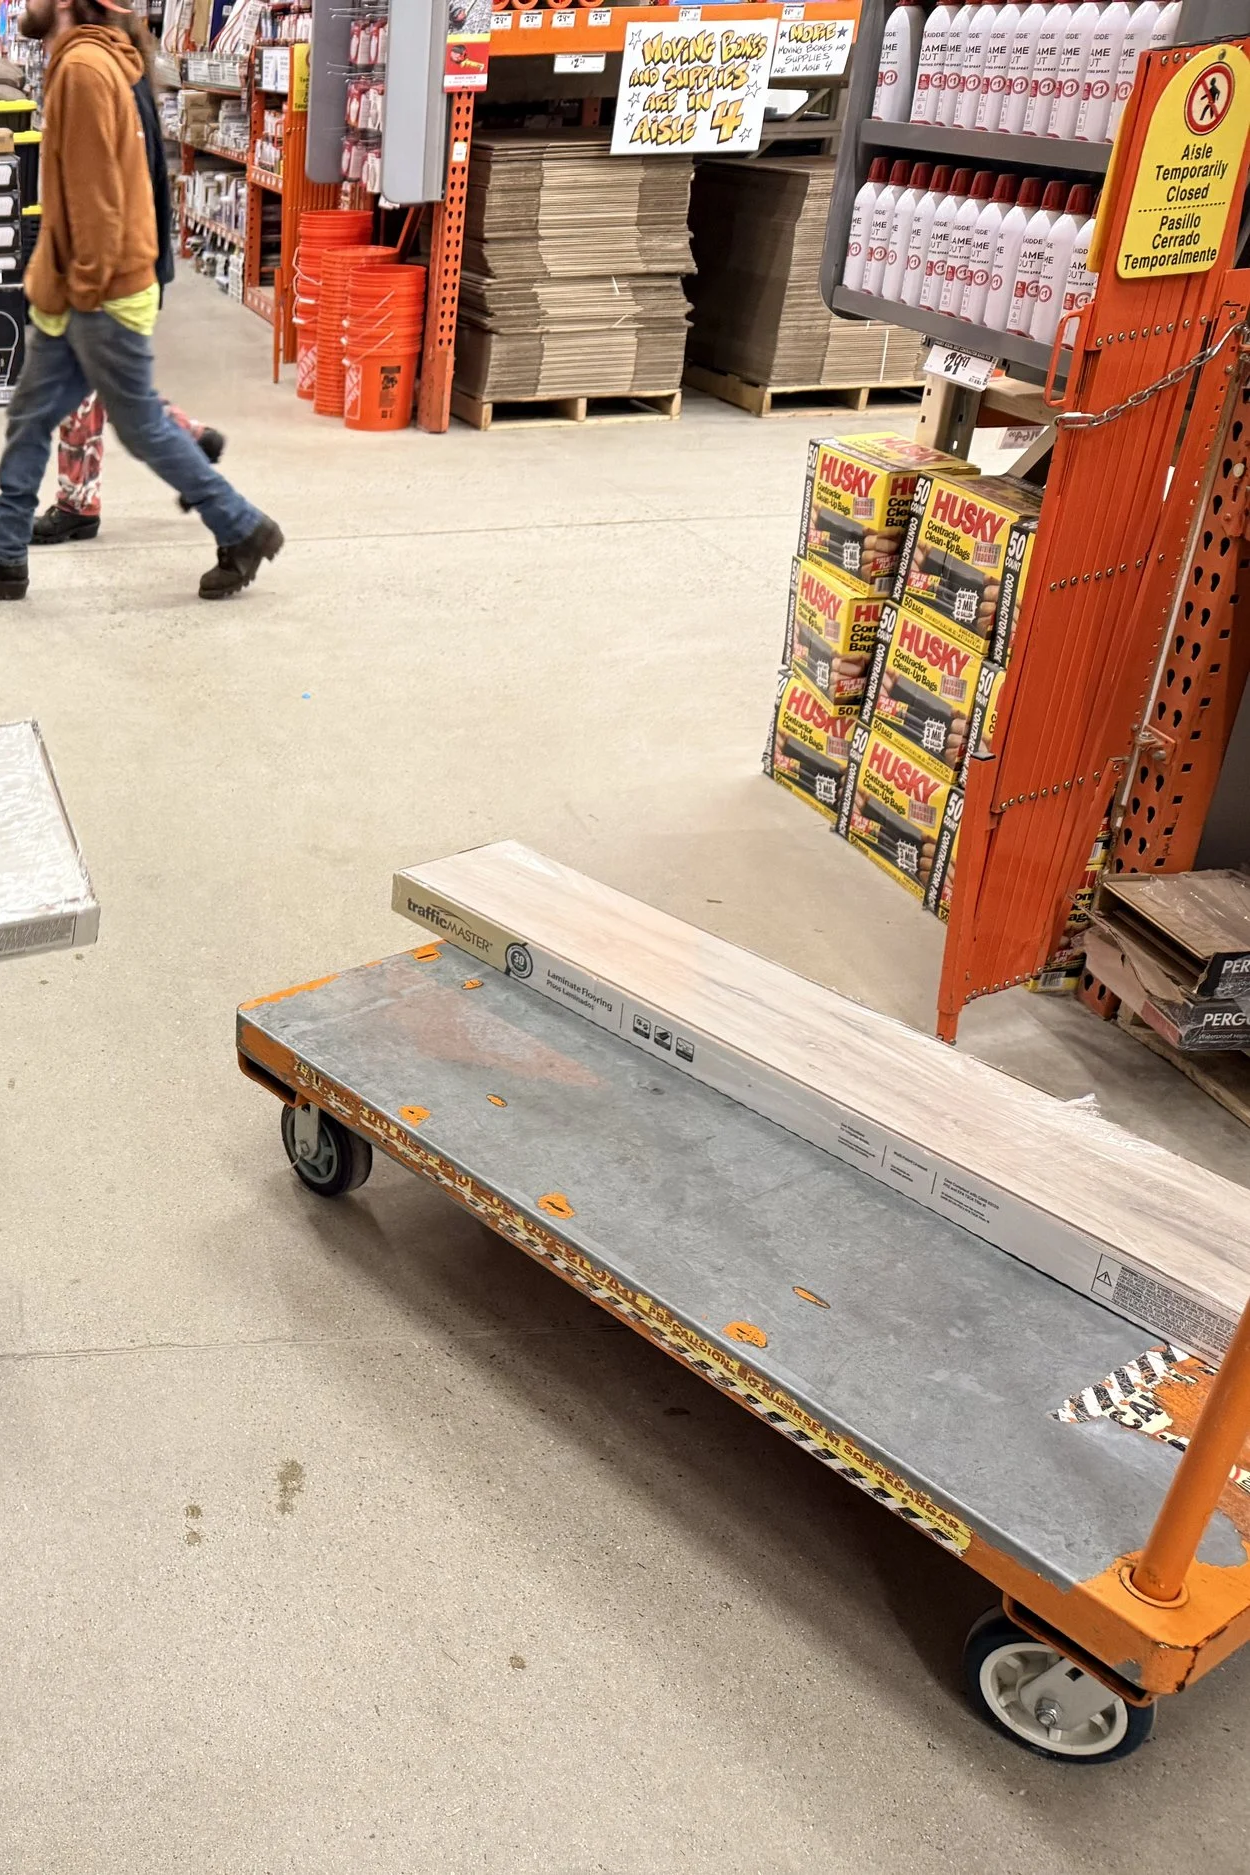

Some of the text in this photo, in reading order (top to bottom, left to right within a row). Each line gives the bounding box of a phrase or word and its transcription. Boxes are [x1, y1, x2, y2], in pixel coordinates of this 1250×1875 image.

[789, 22, 837, 42] MORE
[642, 30, 768, 65] MOVING BOXES
[778, 45, 803, 54] MOVING
[806, 44, 833, 52] BOXES
[785, 53, 830, 63] SUPPLIES
[629, 61, 750, 91] AND SUPPLIES
[825, 62, 832, 71] 4
[643, 88, 713, 113] ARE IN
[629, 98, 744, 145] AISLE 4
[1181, 144, 1213, 161] Aisle
[1155, 160, 1229, 183] Temporarily
[1167, 183, 1210, 203] Closed
[1159, 213, 1201, 231] Pasillo
[1152, 230, 1200, 250] Cerrado
[1124, 248, 1217, 271] Temporalmente
[808, 444, 819, 469] 50
[819, 453, 878, 497] HUSKY
[817, 482, 841, 500] Contractor
[913, 477, 931, 505] 50
[800, 479, 813, 536] CONTRACTOR
[931, 488, 1007, 544] HUSKY
[927, 520, 961, 542] Contractor
[892, 516, 919, 600] CONTRACTOR PACK
[955, 545, 971, 561] Bags
[1007, 530, 1027, 561] 50
[800, 571, 843, 622] HUSKY
[962, 600, 974, 612] MIL
[998, 572, 1015, 634] CONTRACTOR
[879, 607, 897, 634] 50
[894, 649, 927, 673] Contractor
[898, 619, 972, 679] HUSKY
[861, 643, 886, 723] CONTRACTOR PACK
[892, 658, 922, 683] Clean-Up
[921, 675, 938, 692] Bags
[977, 667, 995, 697] 50
[783, 711, 813, 734] Contractor
[786, 686, 856, 740] HUSKY
[852, 729, 869, 755] 50
[864, 769, 894, 797] Contractor
[868, 741, 941, 804] HUSKY
[841, 762, 857, 814] CONTRACTOR
[947, 793, 964, 822] 50
[934, 830, 950, 888] CONTRACTOR
[407, 898, 493, 953] trafficMASTER
[513, 951, 525, 966] 30
[547, 969, 613, 1012] Laminate Flooring
